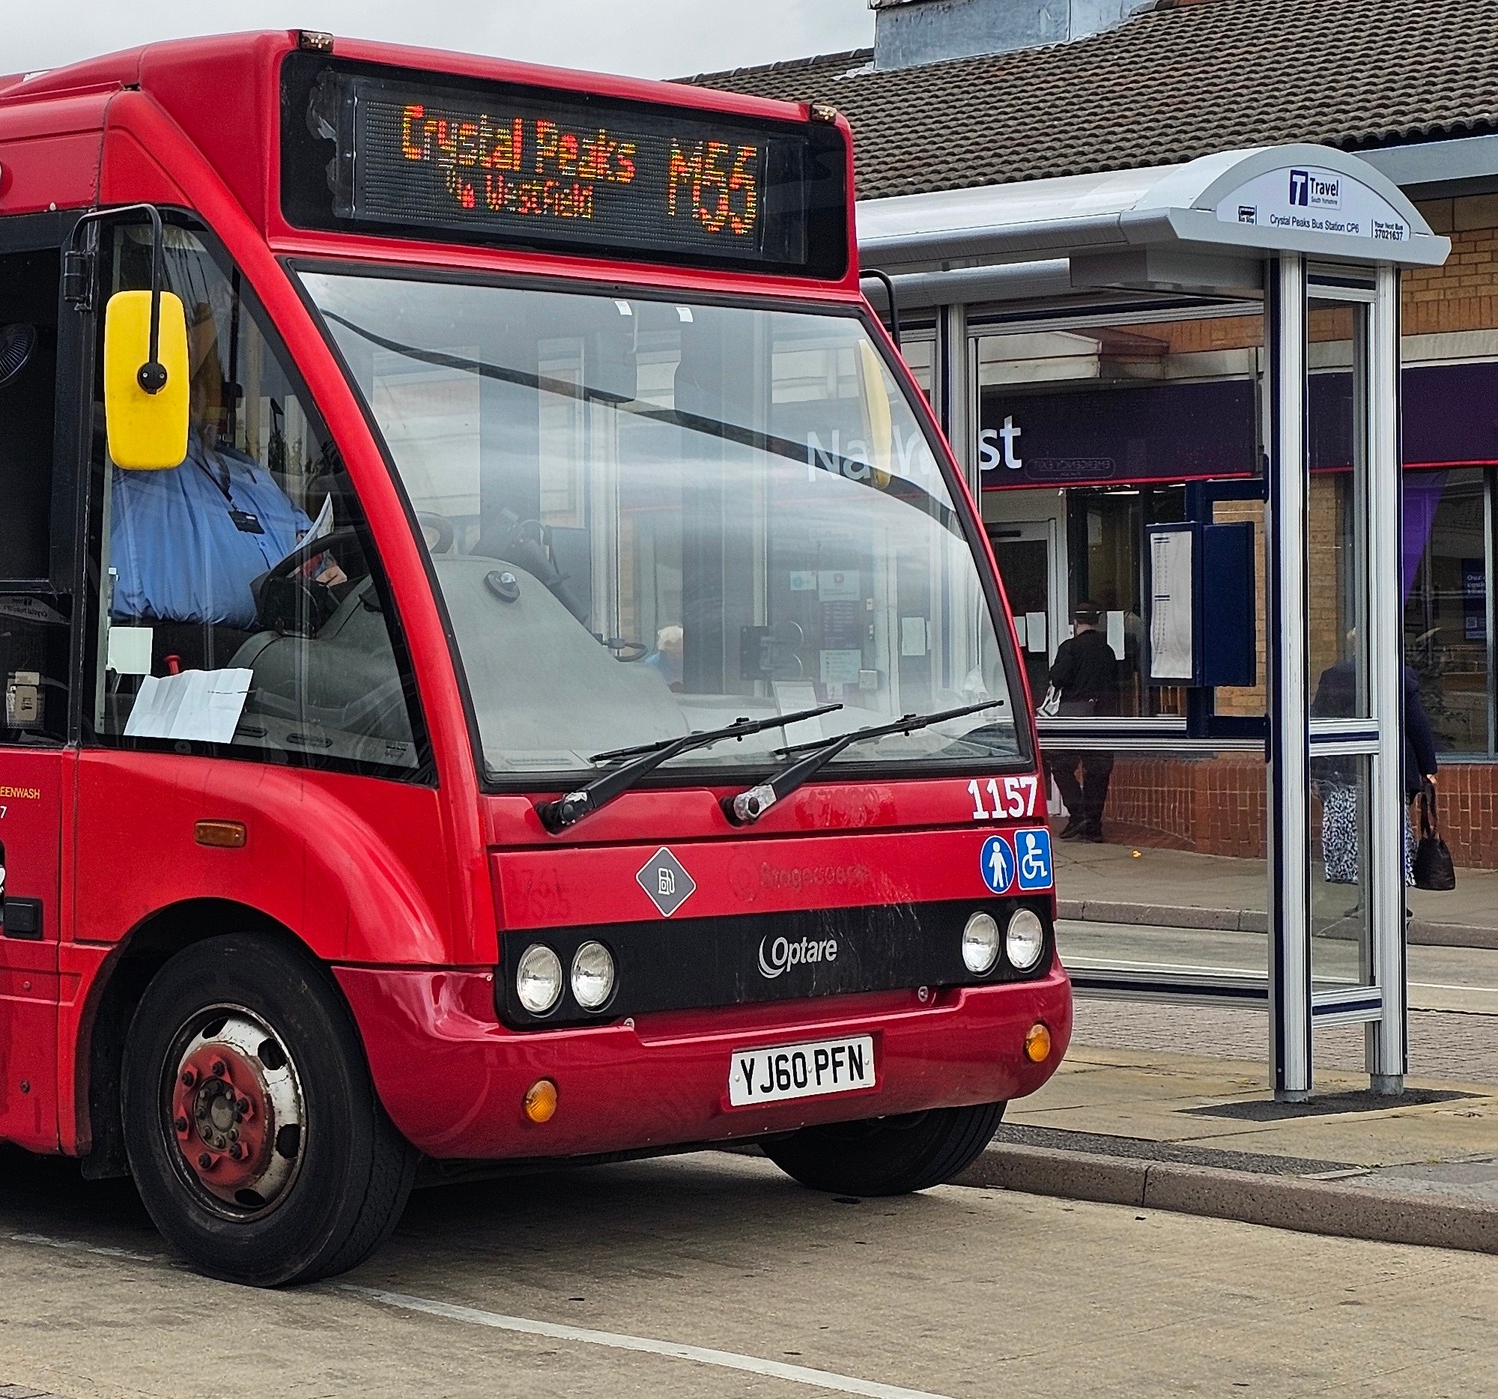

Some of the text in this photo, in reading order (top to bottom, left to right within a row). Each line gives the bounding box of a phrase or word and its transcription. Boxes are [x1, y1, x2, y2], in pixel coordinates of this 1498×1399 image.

[402, 104, 637, 184] Crystal Peaks
[667, 137, 758, 235] M55
[1310, 177, 1339, 196] Travel
[1270, 214, 1359, 234] Crystal Peaks Bus Station CP6
[968, 777, 1038, 820] 1157
[770, 936, 838, 972] Optare
[740, 1044, 865, 1096] YJ60 PFN
